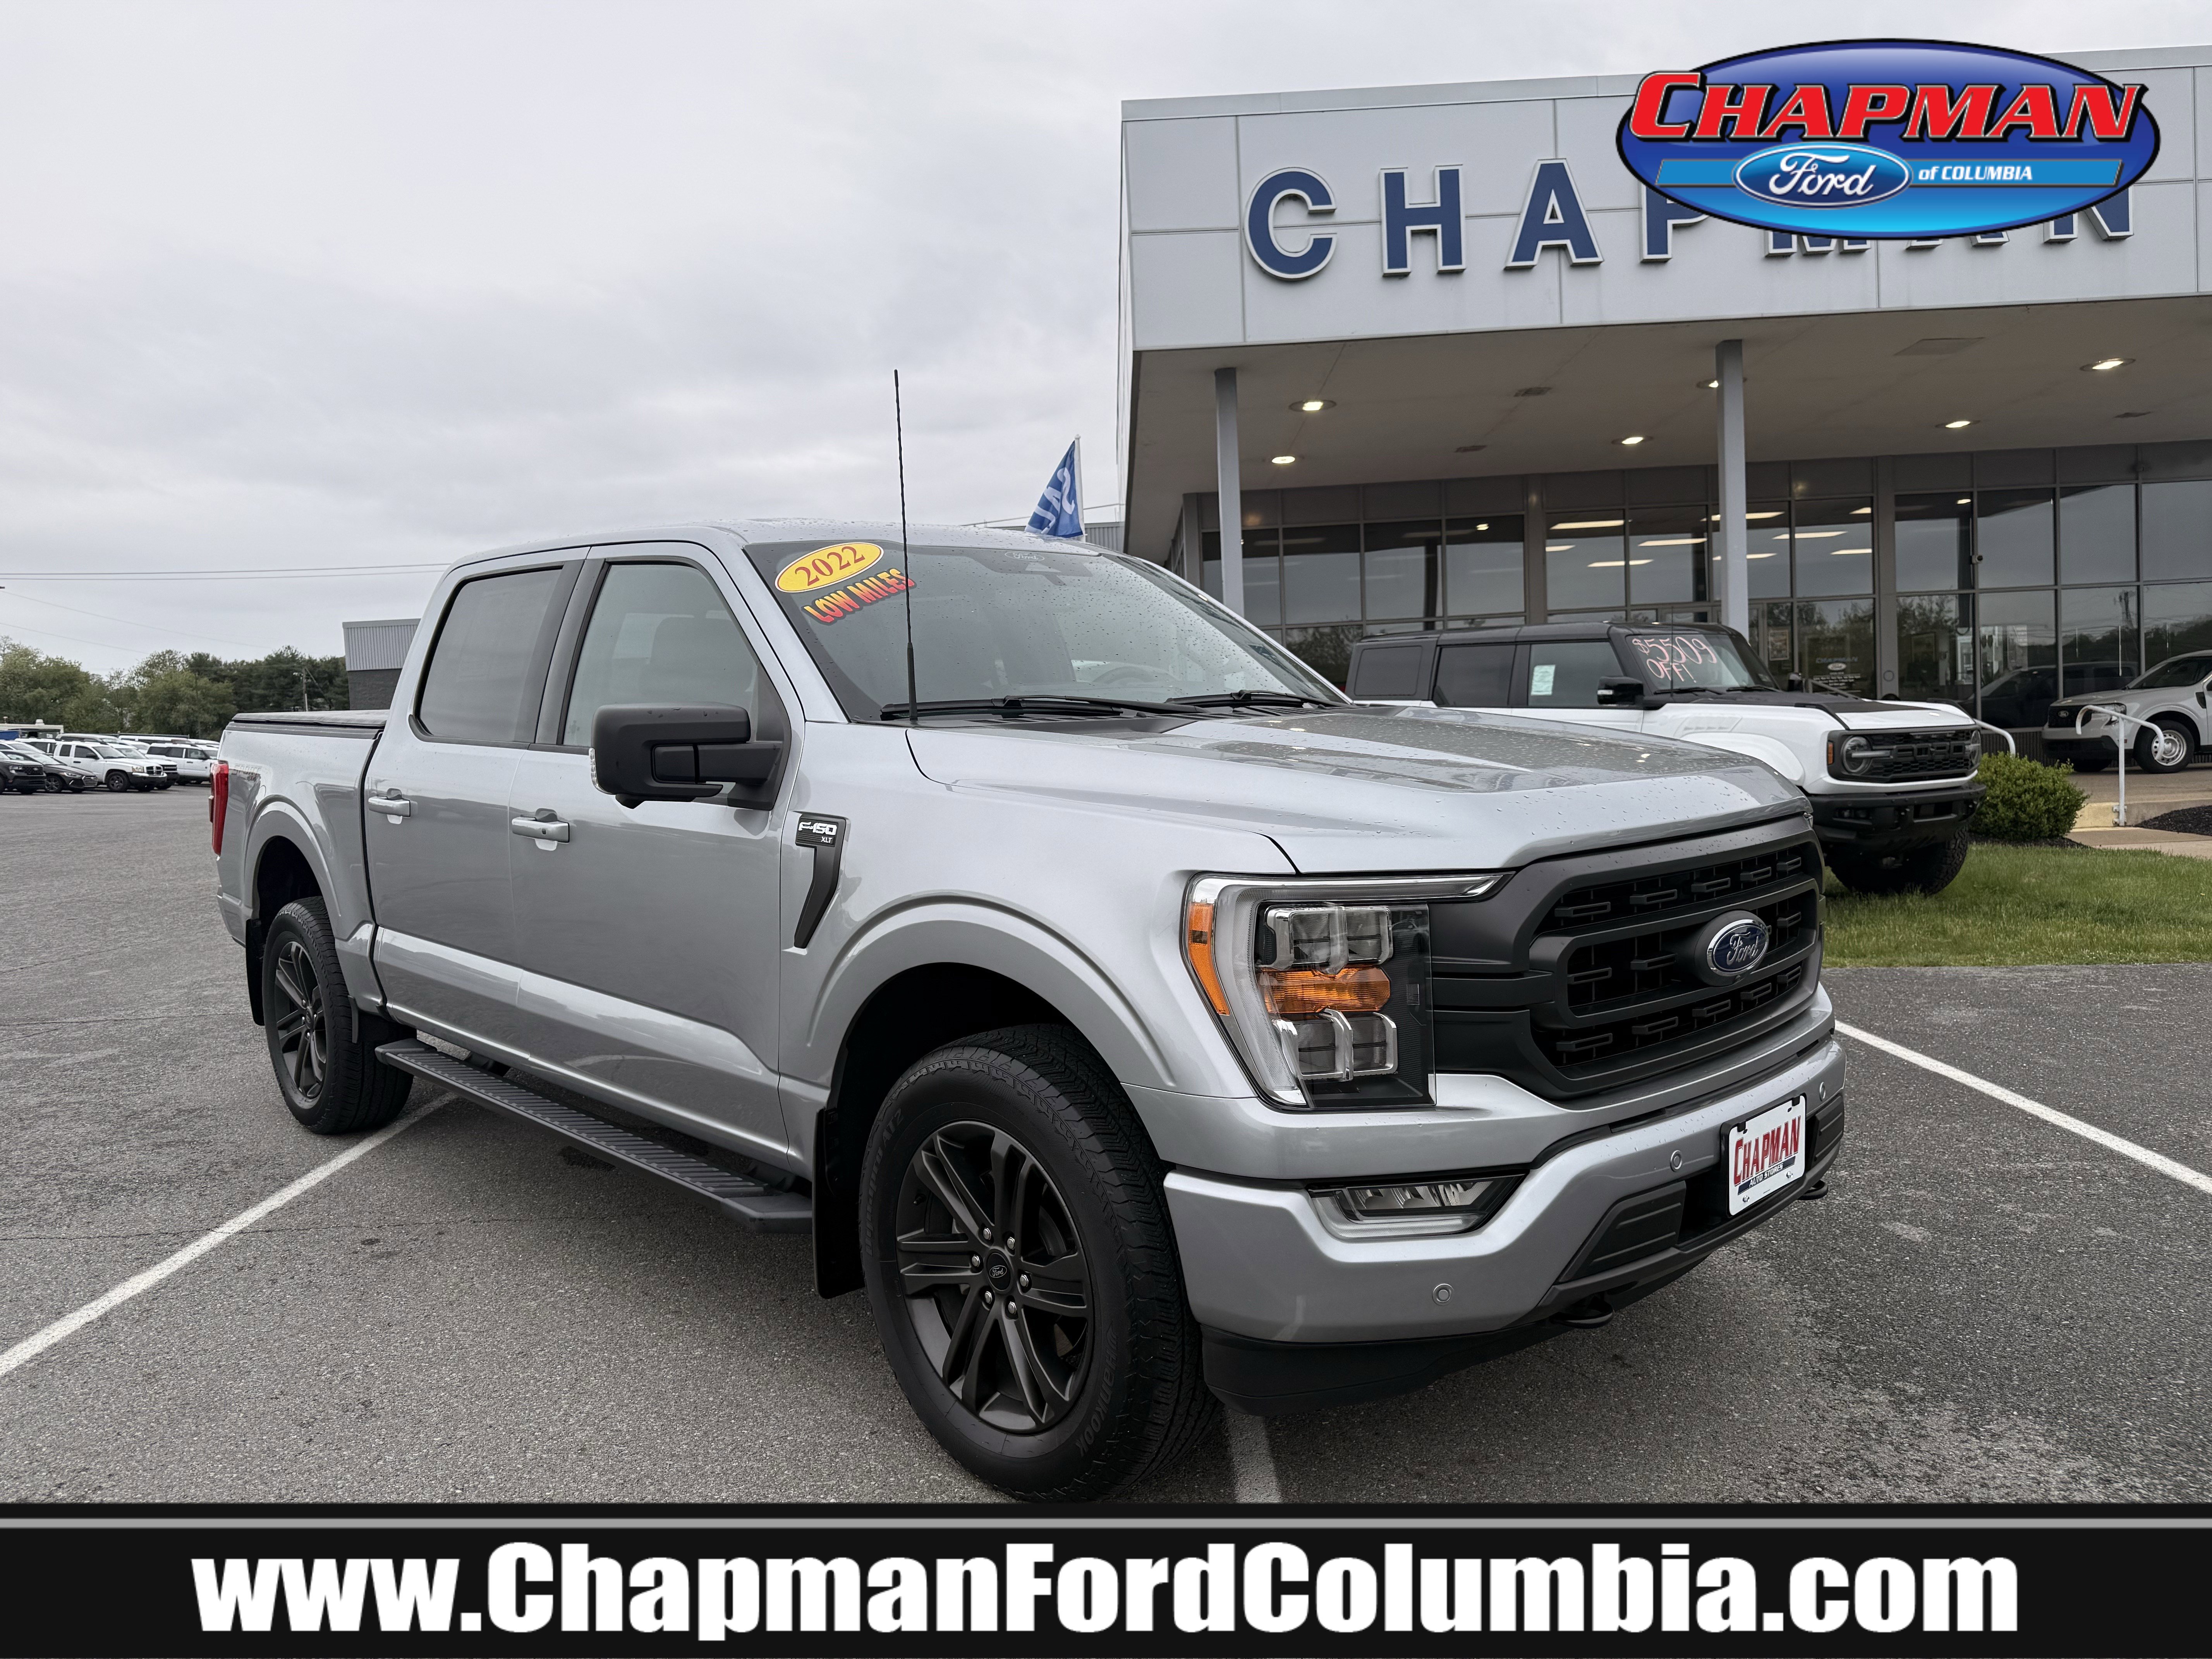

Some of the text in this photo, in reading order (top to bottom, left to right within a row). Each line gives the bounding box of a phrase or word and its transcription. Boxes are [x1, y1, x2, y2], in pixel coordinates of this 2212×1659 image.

[1244, 157, 2134, 283] CHAP
[795, 546, 866, 586] 2022
[804, 568, 915, 623] LOW MILES
[1646, 658, 1697, 683] OFF!
[798, 822, 837, 835] F-150
[1726, 931, 1759, 966] Ford
[1734, 1115, 1801, 1187] CHAPMAN
[1749, 1163, 1783, 1187] AUTO STORES
[992, 1267, 1004, 1277] Ford
